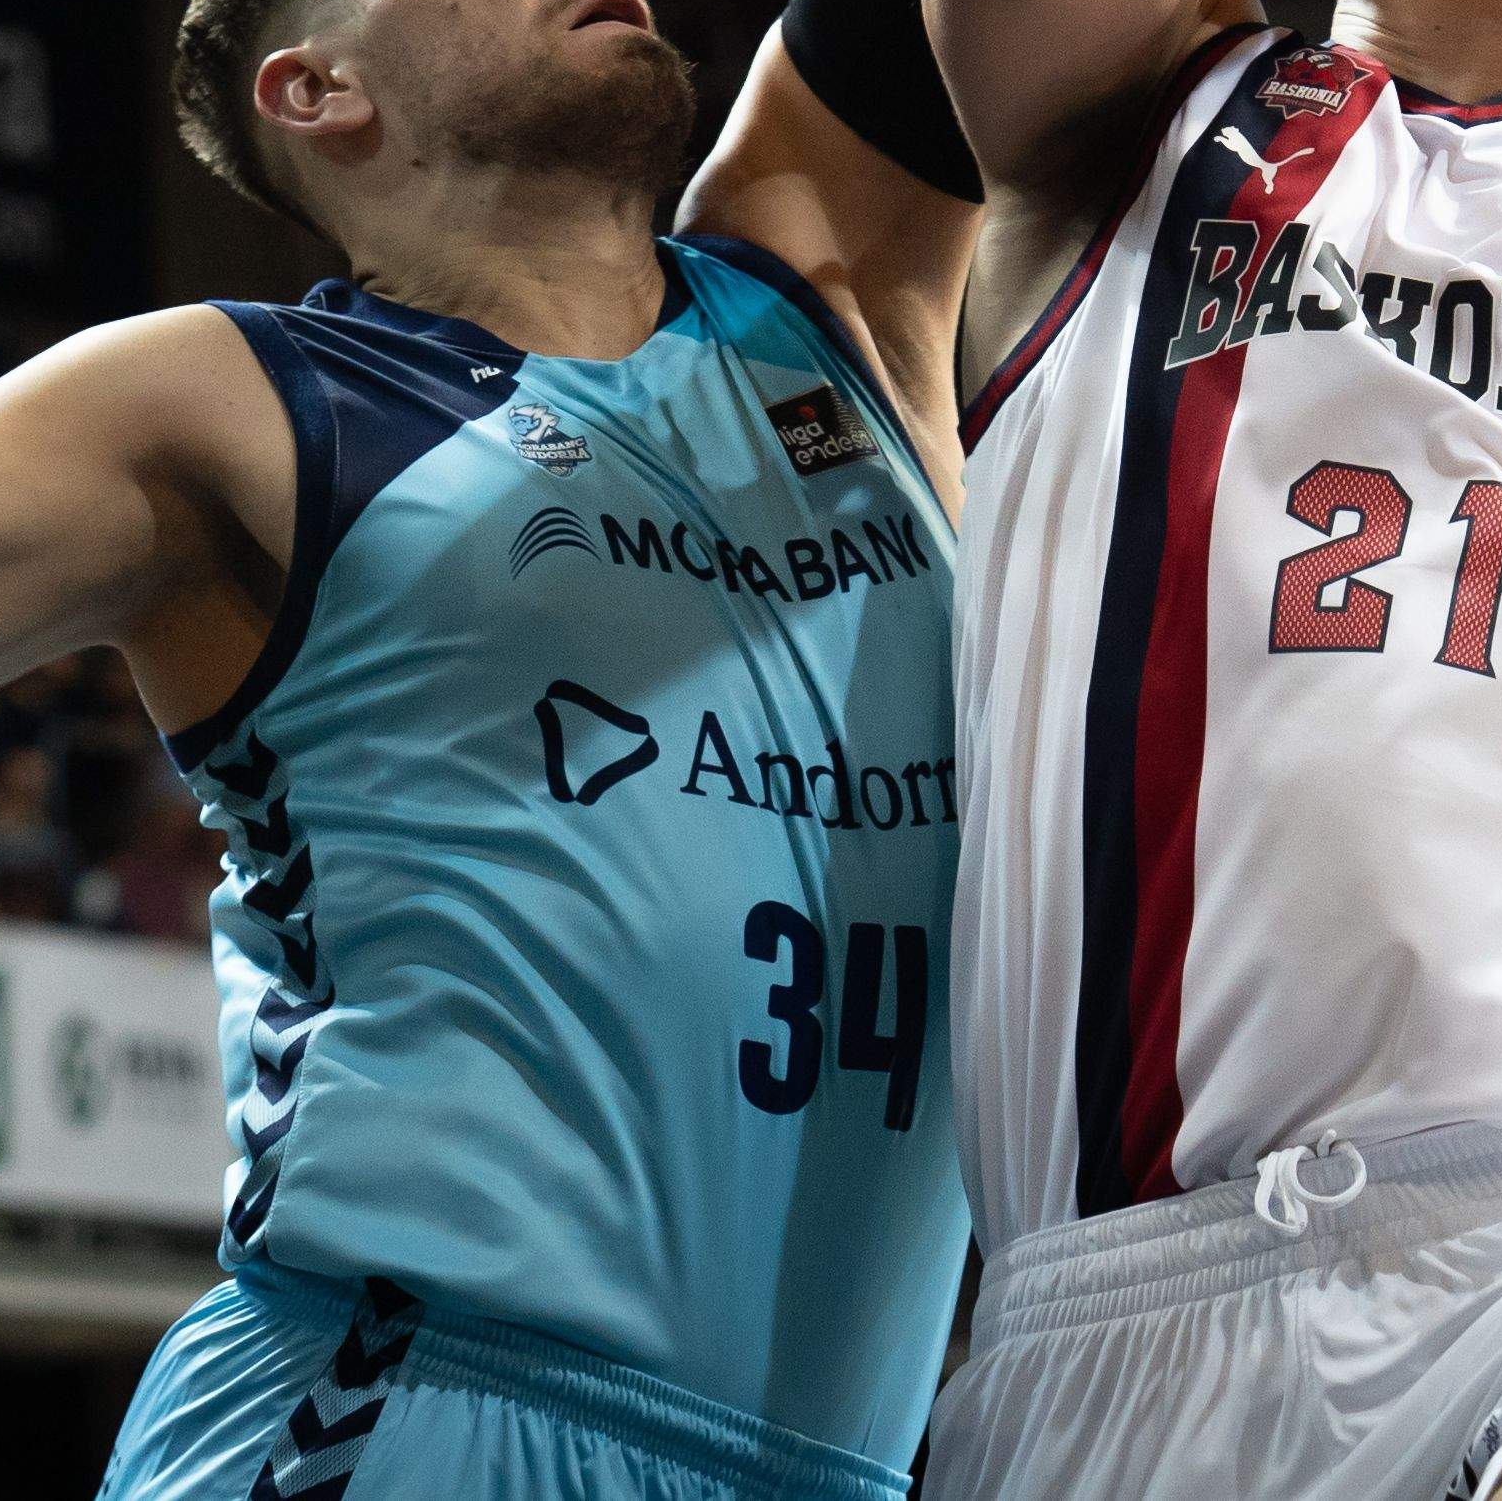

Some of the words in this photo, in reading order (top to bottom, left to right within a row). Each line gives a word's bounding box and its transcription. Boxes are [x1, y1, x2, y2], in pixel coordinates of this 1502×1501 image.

[1264, 81, 1342, 107] BASKONIA
[778, 422, 825, 447] liga
[739, 900, 929, 1132] 34
